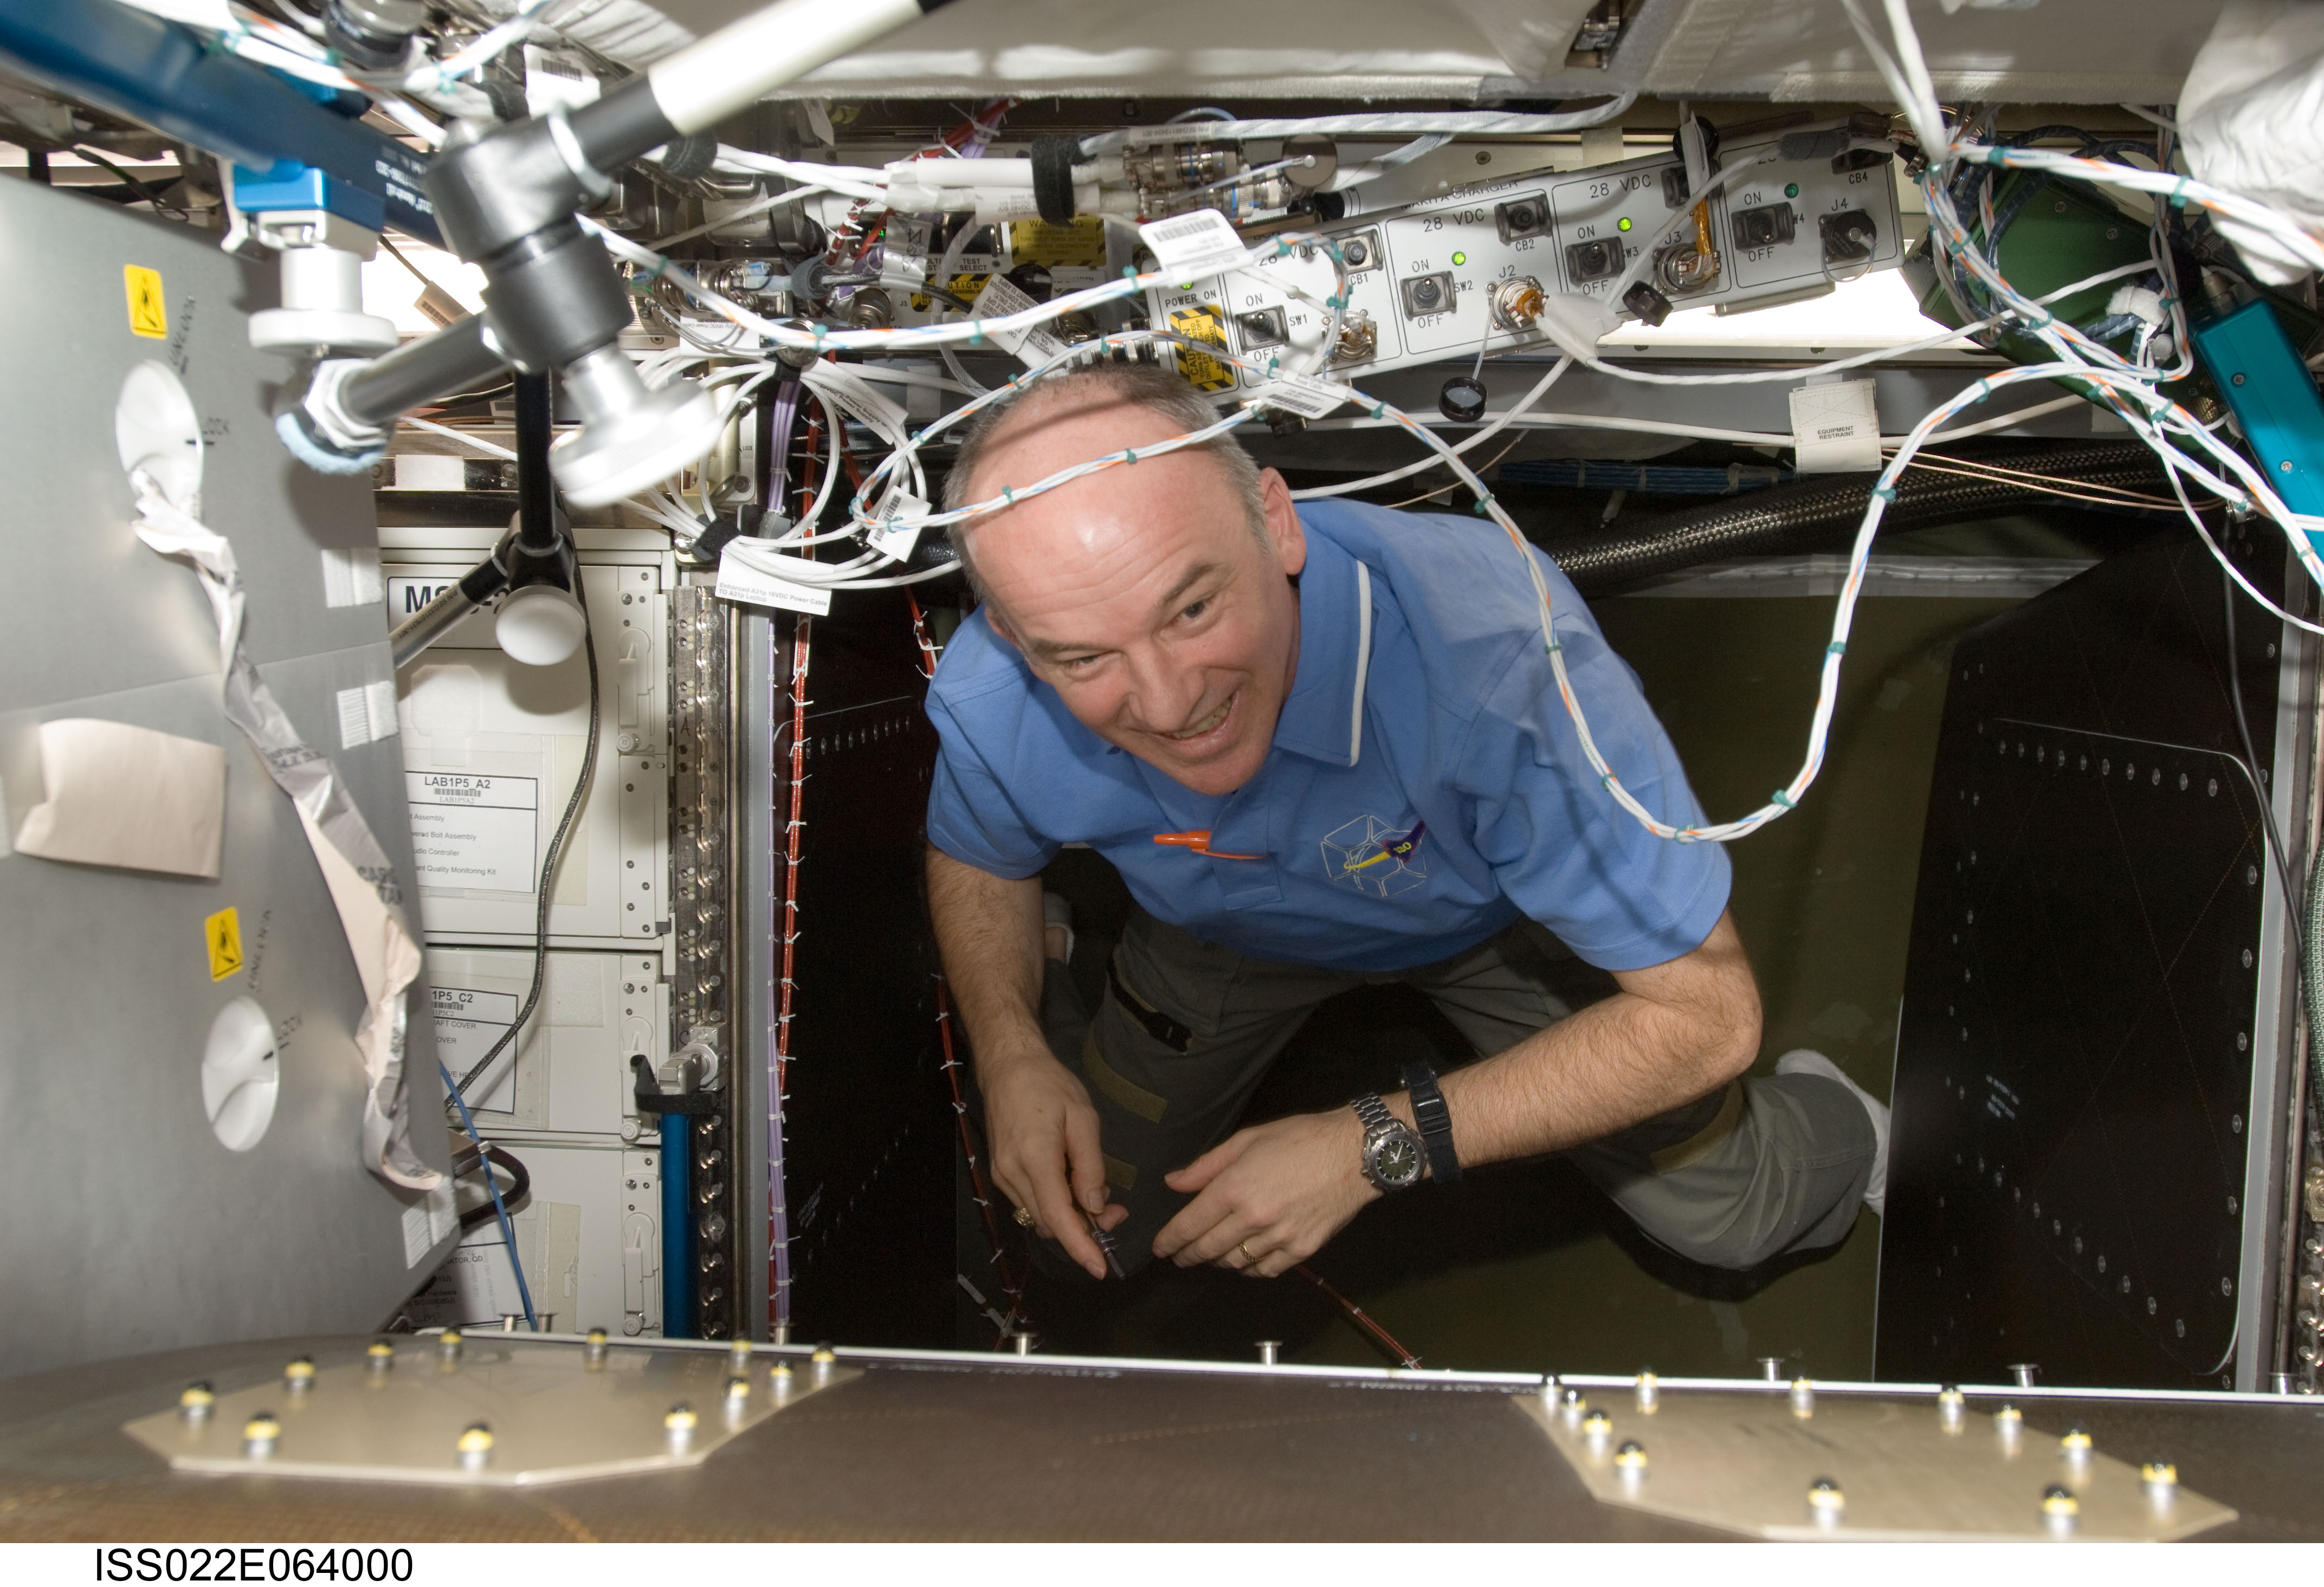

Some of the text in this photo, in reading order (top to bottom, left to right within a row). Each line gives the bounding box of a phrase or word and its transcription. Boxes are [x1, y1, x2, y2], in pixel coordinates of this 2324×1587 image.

[1849, 172, 1869, 184] CB4
[1590, 174, 1651, 198] 28 VDC
[1744, 191, 1761, 205] ON
[1831, 198, 1849, 211] J4
[1423, 208, 1485, 232] 28 VDC
[1578, 225, 1595, 239] ON
[1664, 231, 1682, 244] J3
[1515, 239, 1535, 252] CB2
[1291, 245, 1319, 260] VDC
[1748, 247, 1774, 262] OFF
[1412, 259, 1429, 273] ON
[1499, 264, 1516, 278] J2
[999, 278, 1014, 289] AMPS
[1350, 273, 1368, 286] CB1
[989, 280, 1018, 304] CONTINUOUS
[1454, 280, 1473, 293] SW2
[1583, 280, 1609, 295] OFF
[986, 296, 997, 306] GFE
[993, 292, 1018, 313] VDC ONLY)
[1165, 289, 1216, 308] POWER ON
[1246, 293, 1263, 306] ON
[1289, 314, 1307, 326] SW1
[1418, 313, 1444, 328] OFF
[1182, 328, 1199, 375] CAUTN
[1254, 346, 1280, 362] OFF
[839, 394, 856, 409] Power
[855, 407, 874, 423] Supply
[845, 392, 863, 408] Power
[862, 406, 881, 423] Supply
[1817, 425, 1854, 435] EQUIPMENT
[1819, 431, 1855, 440] RESTRAINT
[719, 582, 750, 592] Enhanced
[751, 587, 767, 596] A31p
[769, 591, 789, 599] 16VDC
[790, 594, 810, 603] Power
[729, 590, 745, 599] A31p
[746, 594, 767, 603] Laptop
[440, 796, 475, 804] LAB1P5A2
[414, 813, 445, 823] Assembly
[444, 832, 476, 841] Assembly
[428, 848, 460, 856] Controller
[1393, 841, 1411, 854] 130
[427, 865, 449, 874] Quality
[451, 866, 485, 876] Monitoring
[451, 1021, 476, 1029] COVER
[472, 1255, 483, 1263] QD
